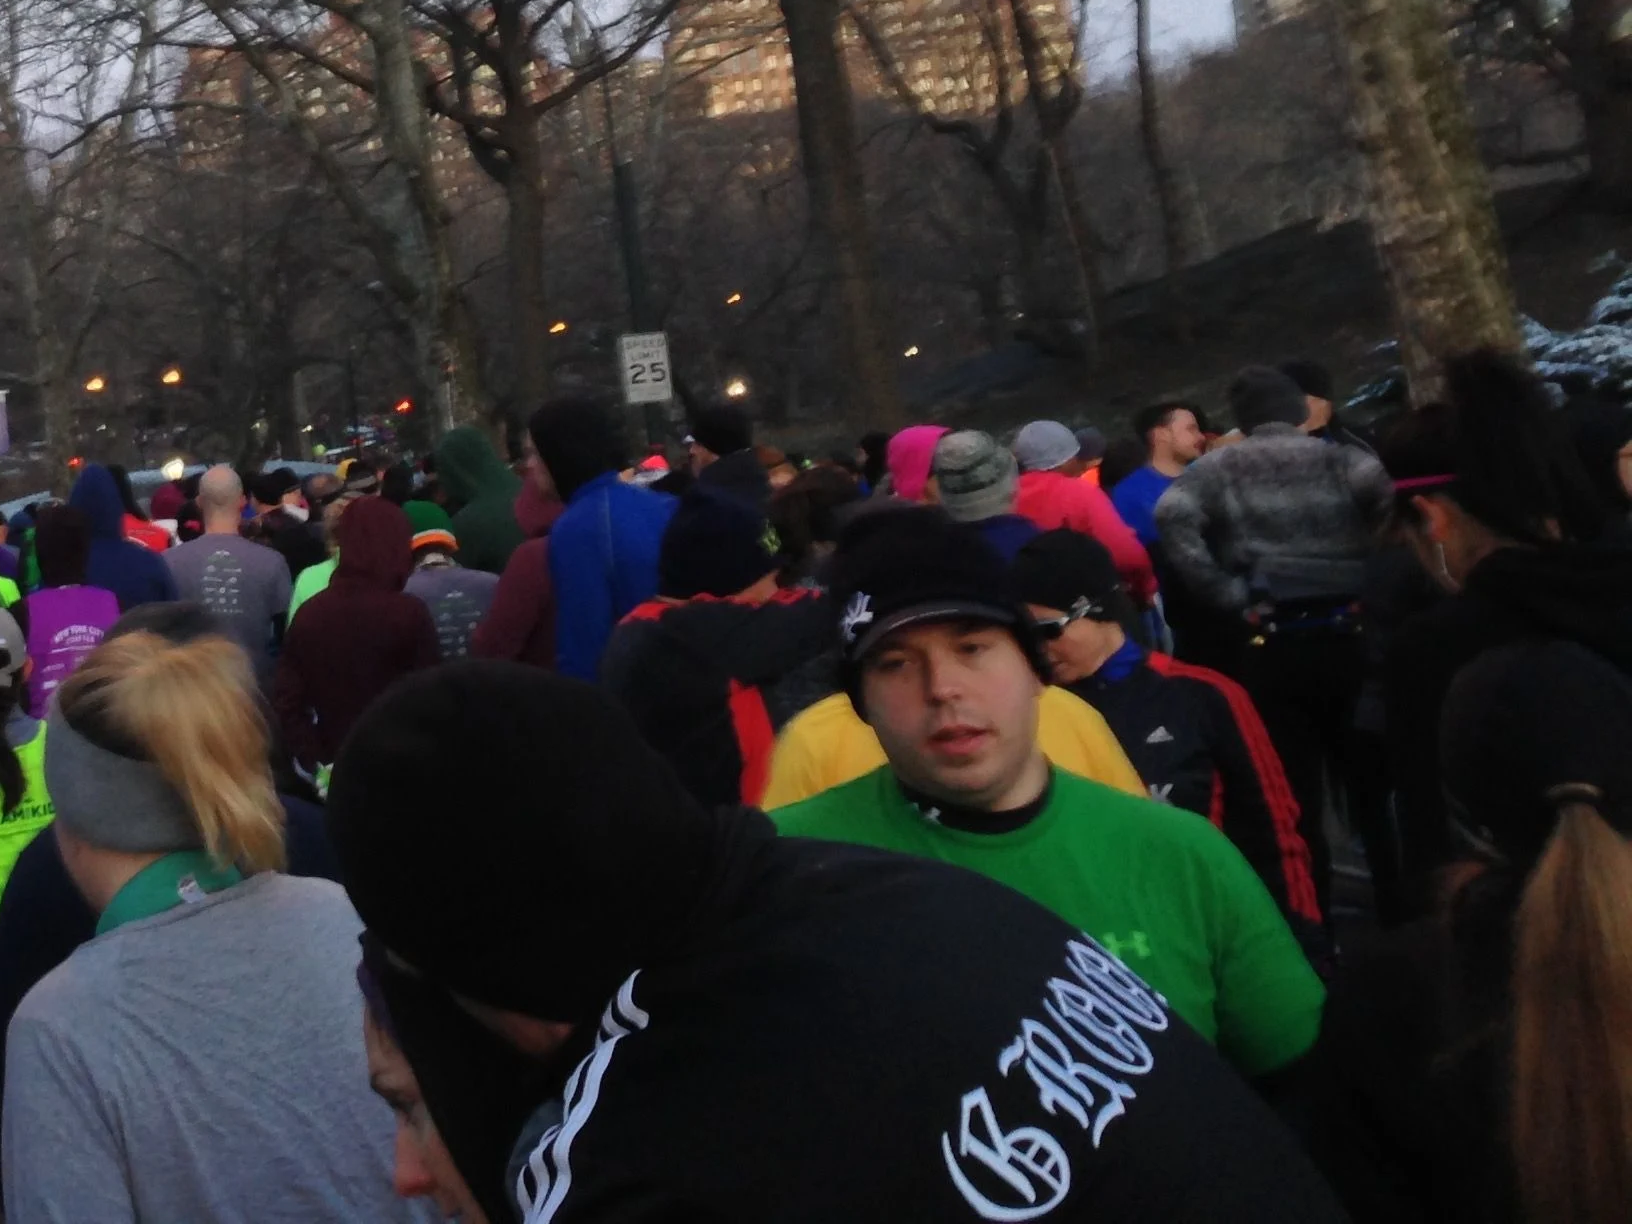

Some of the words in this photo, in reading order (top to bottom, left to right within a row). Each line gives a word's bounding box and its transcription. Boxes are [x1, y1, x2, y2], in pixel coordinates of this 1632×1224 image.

[625, 338, 666, 350] SPEED
[631, 350, 661, 361] LIMIT
[629, 362, 666, 385] 25
